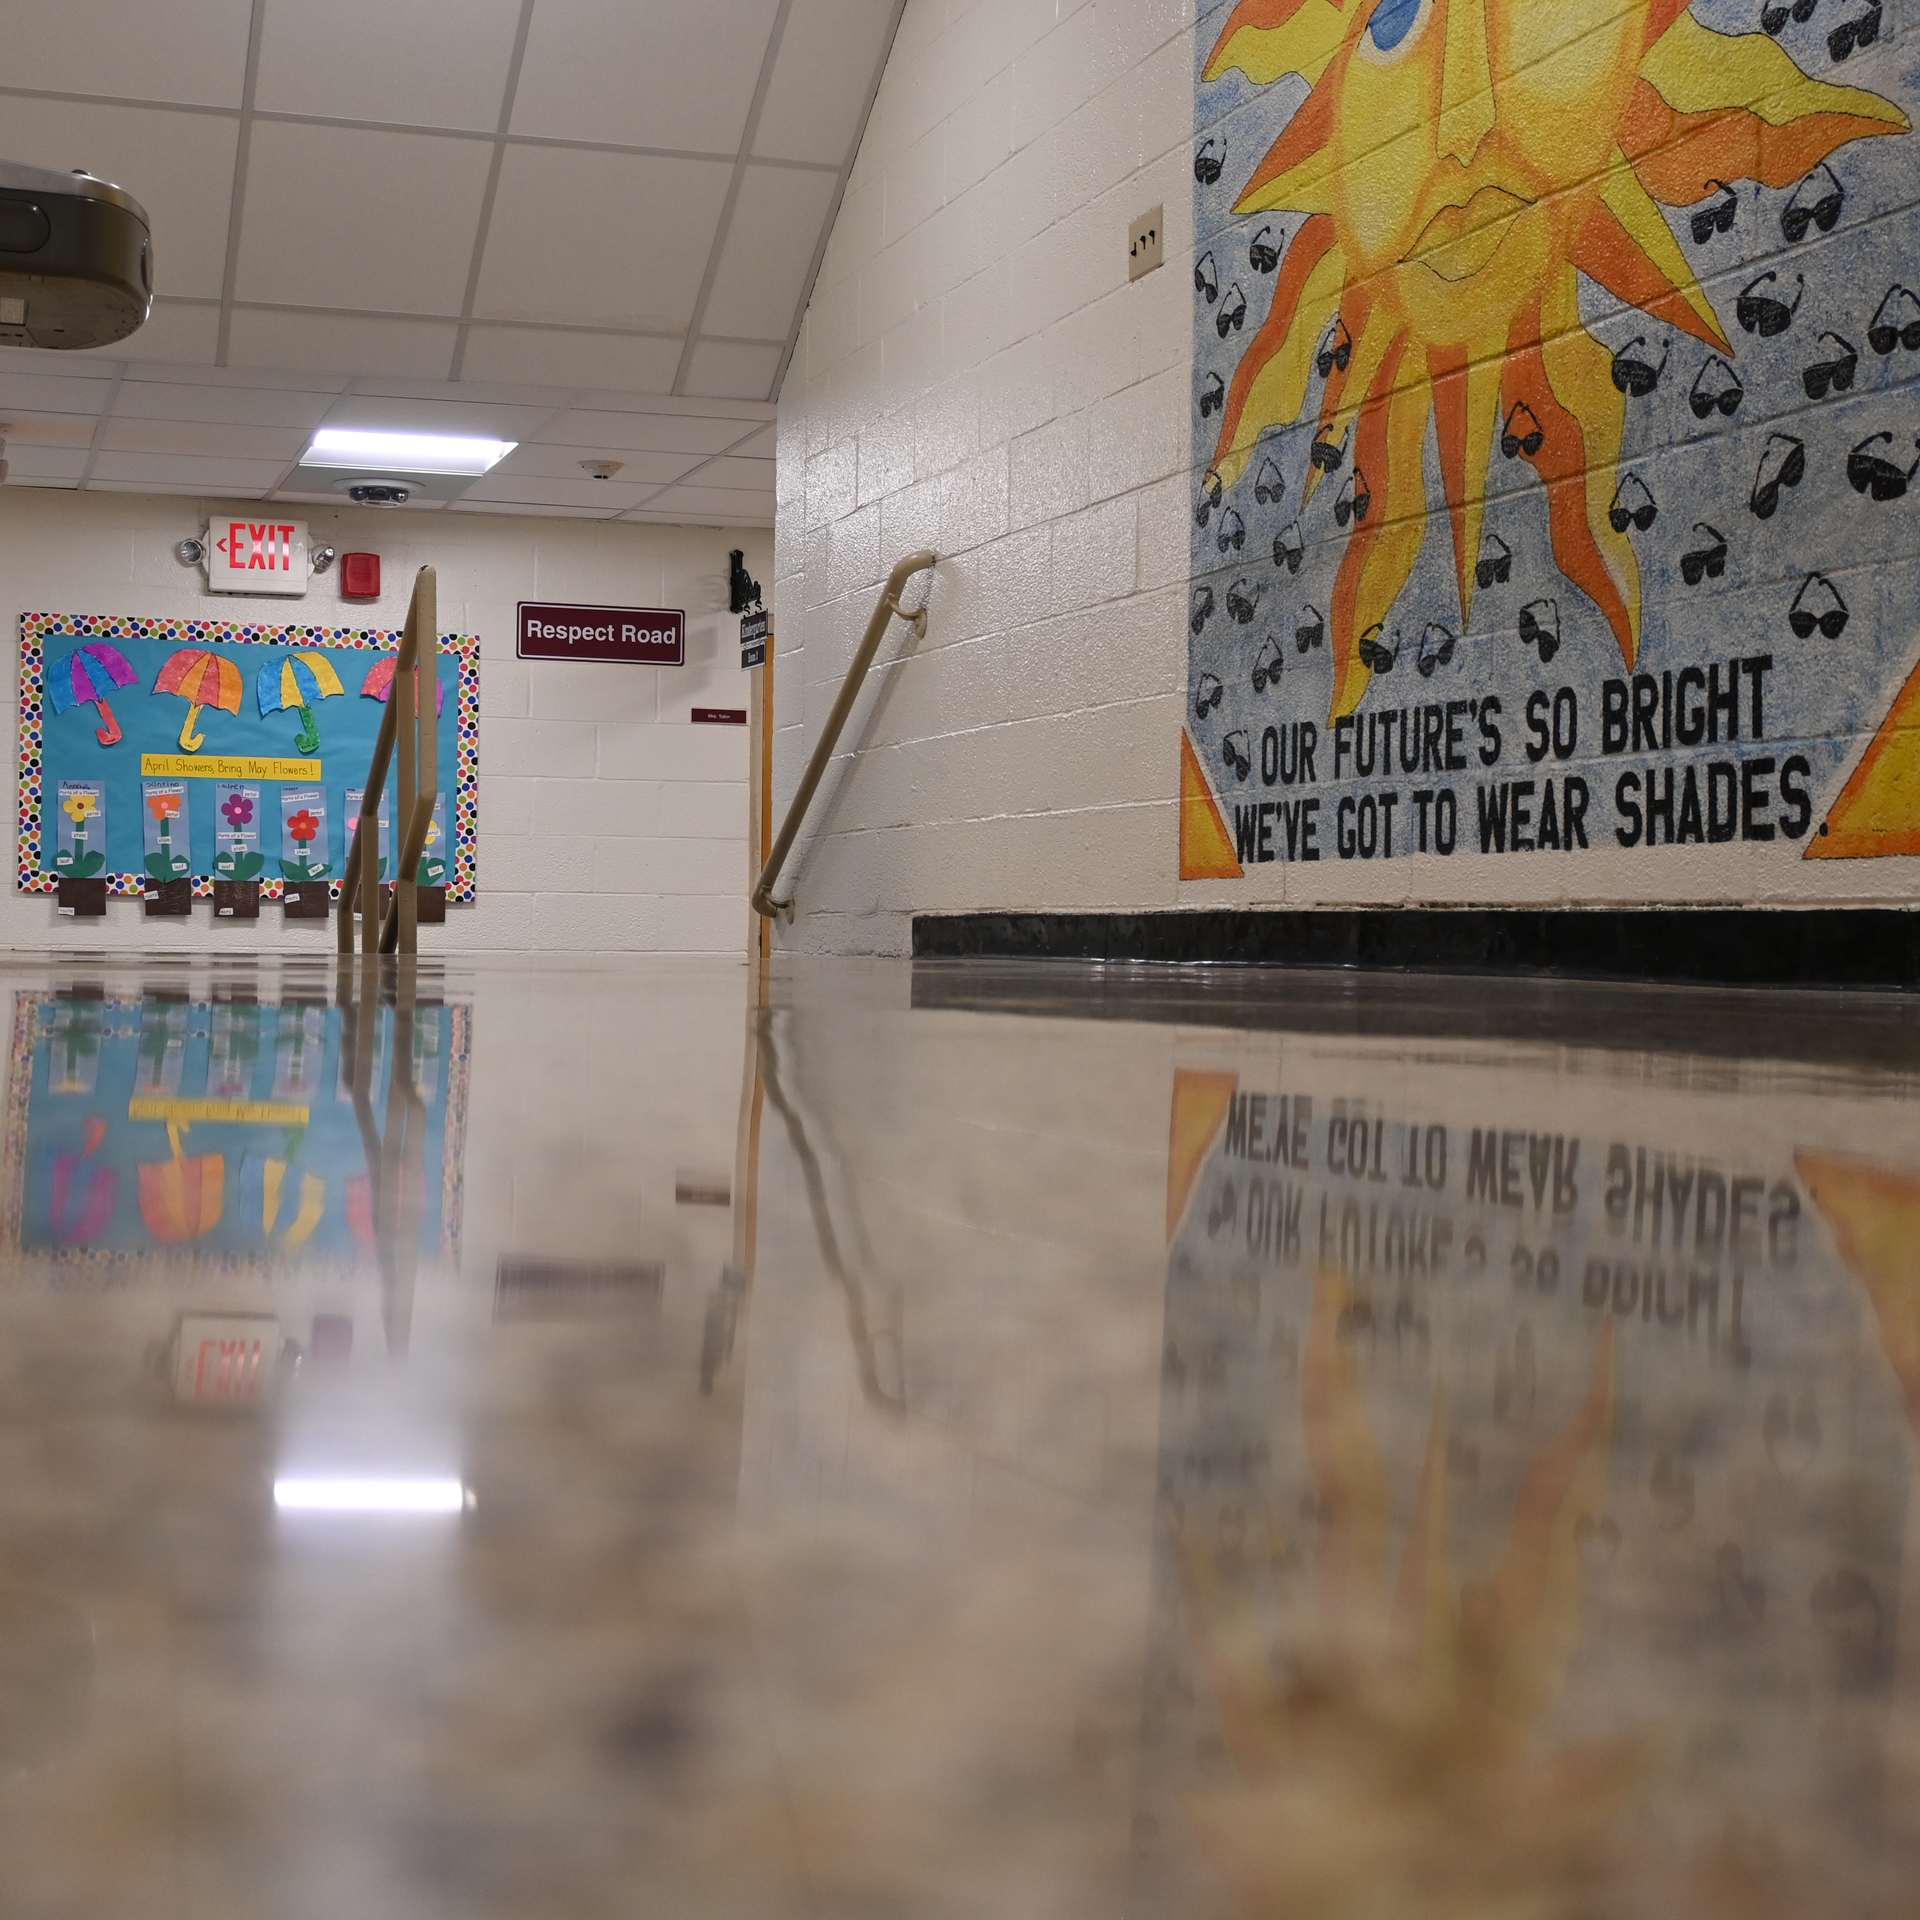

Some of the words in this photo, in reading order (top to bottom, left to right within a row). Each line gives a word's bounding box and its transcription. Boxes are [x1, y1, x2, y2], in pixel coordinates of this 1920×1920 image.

[229, 522, 296, 571] EXIT
[527, 619, 615, 645] Respect
[621, 624, 676, 645] Road
[1261, 720, 1317, 787] OUR
[1334, 695, 1502, 780] FUTURE'S
[1525, 686, 1578, 762] SO
[1602, 654, 1773, 755] BRIGHT
[144, 757, 170, 775] April
[175, 758, 215, 775] Showers,
[217, 760, 243, 778] Bring
[248, 761, 267, 779] May
[1235, 798, 1320, 864] WE'VE
[1337, 791, 1398, 860] GOT
[1413, 788, 1457, 856] TO
[1477, 776, 1589, 854] WEAR
[1615, 754, 1829, 848] SHADES.
